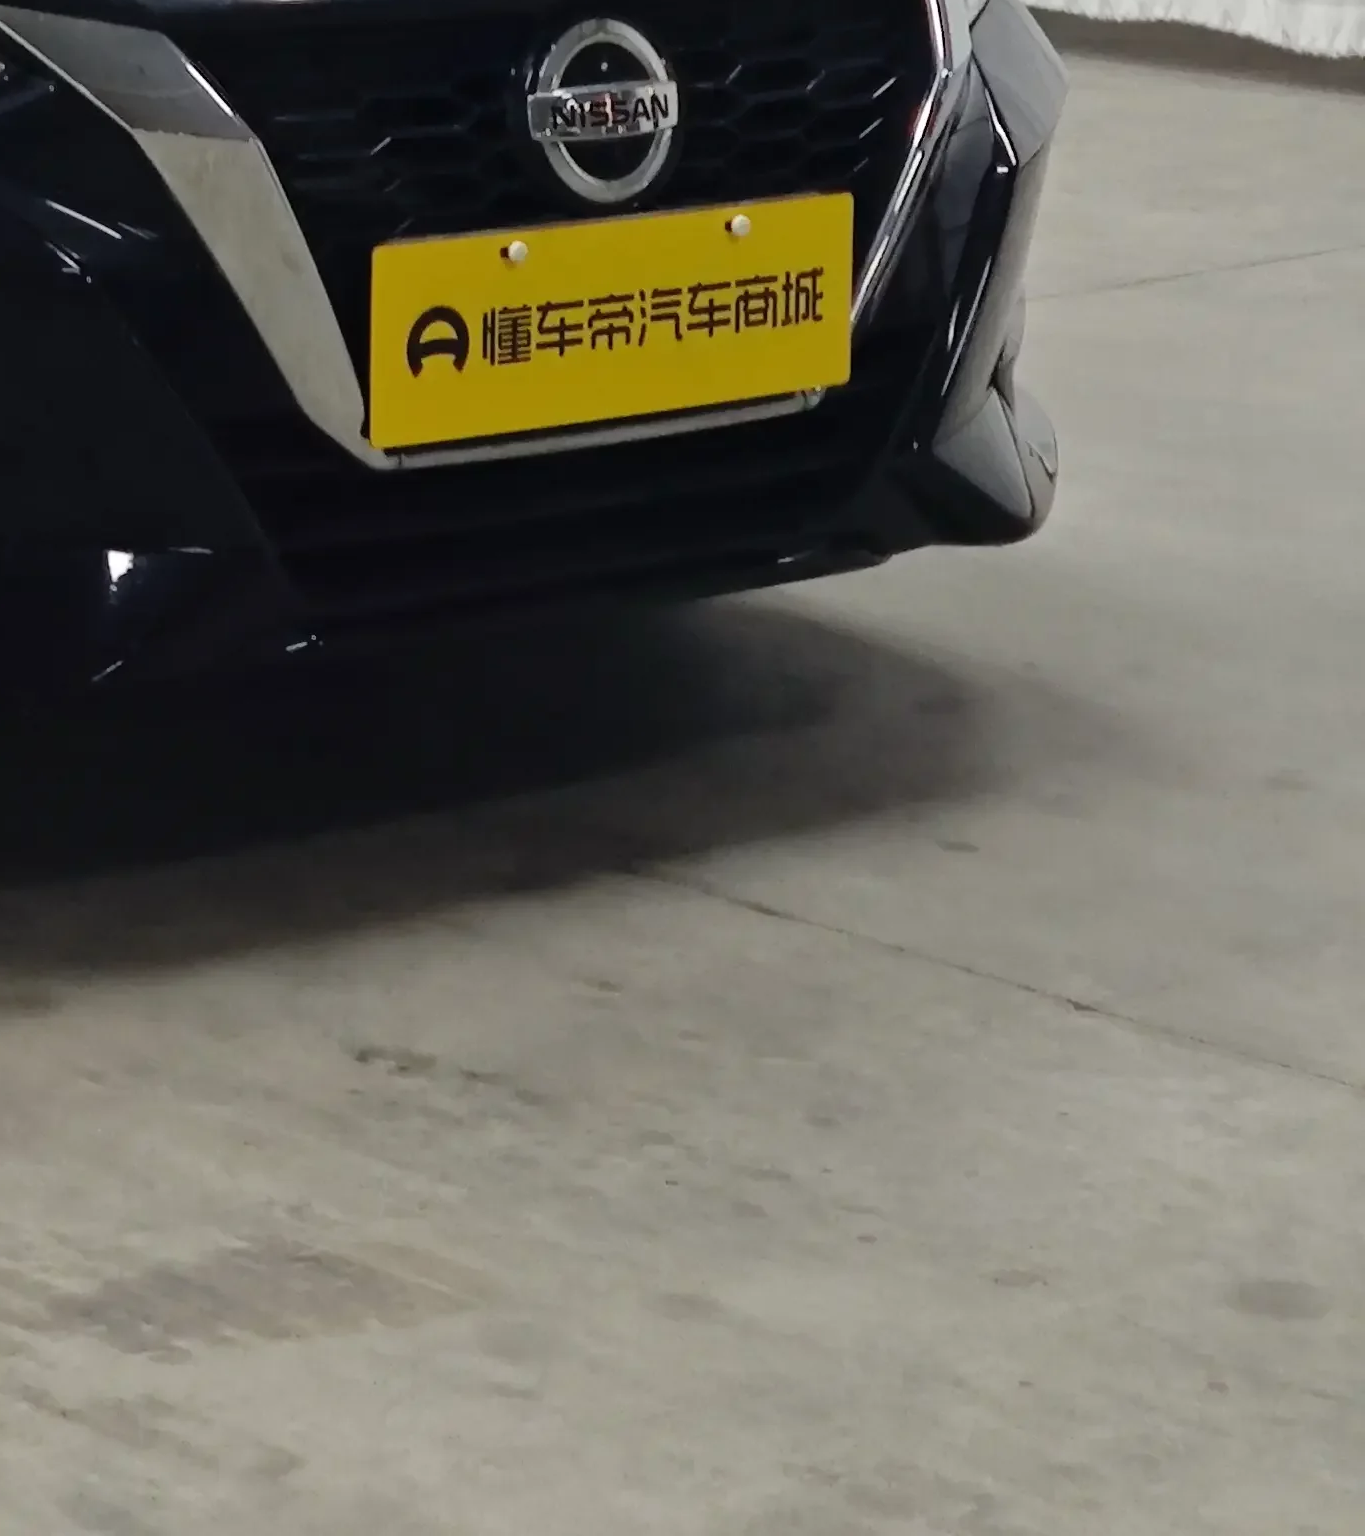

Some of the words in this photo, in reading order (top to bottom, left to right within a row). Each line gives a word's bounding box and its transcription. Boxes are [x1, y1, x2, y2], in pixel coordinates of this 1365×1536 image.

[550, 93, 669, 129] NISSAN
[481, 266, 824, 366] 懂车帝汽车商城
